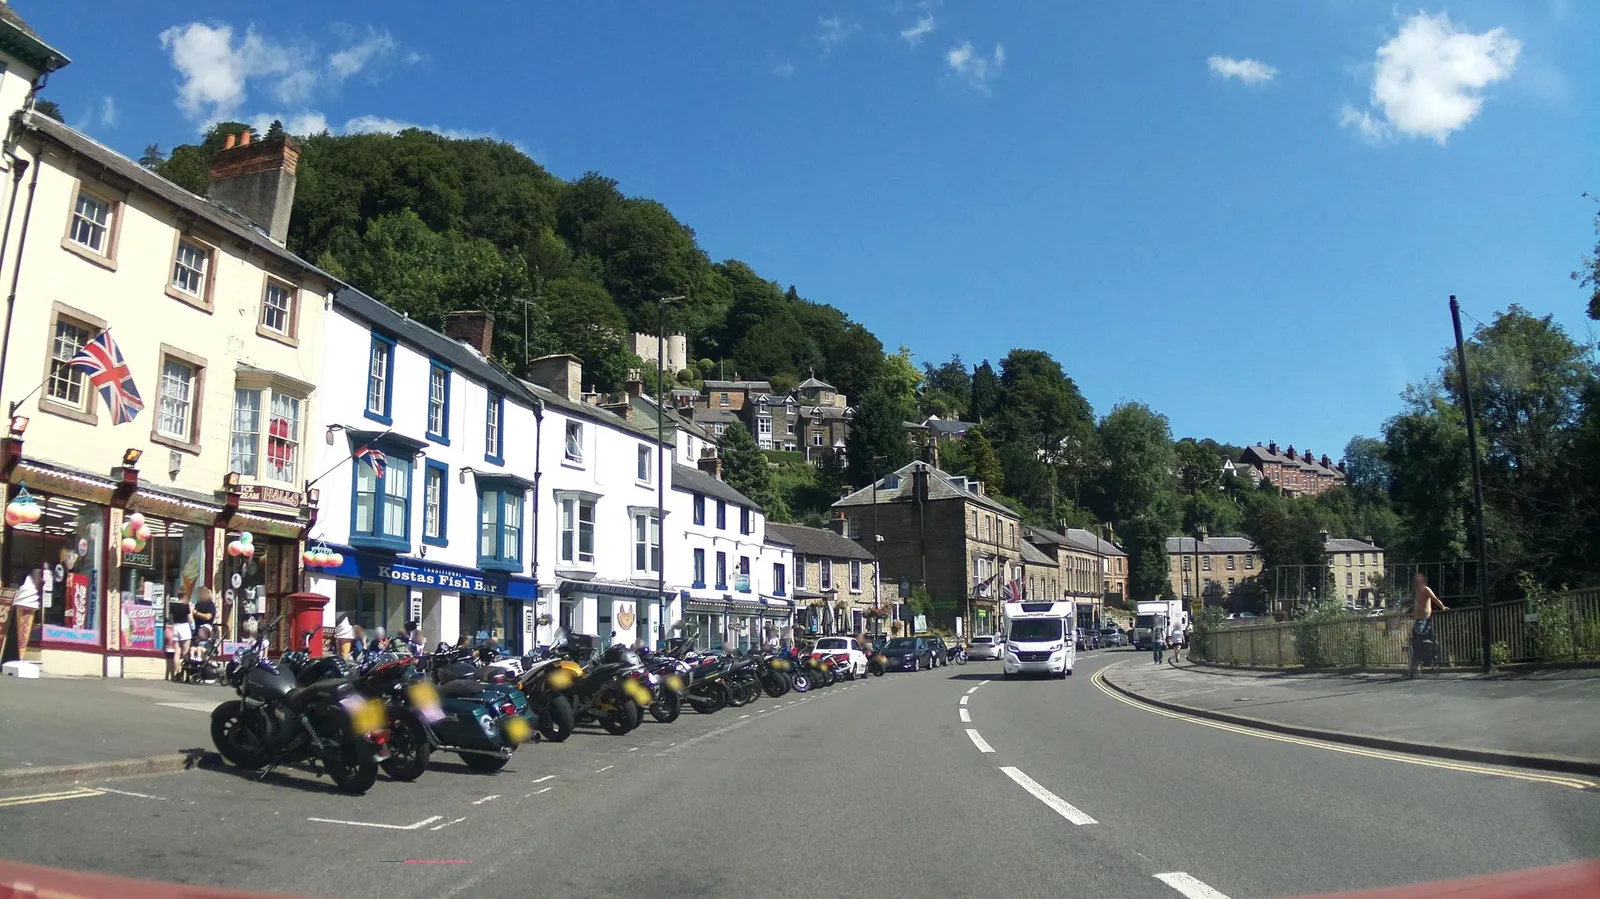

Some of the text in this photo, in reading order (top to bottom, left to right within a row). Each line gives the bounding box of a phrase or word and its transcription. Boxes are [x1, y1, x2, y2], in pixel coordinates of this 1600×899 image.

[240, 485, 254, 493] ICE
[264, 487, 299, 507] HALLS
[123, 552, 150, 564] COFFEE
[377, 565, 497, 593] Kostas Fish Bar
